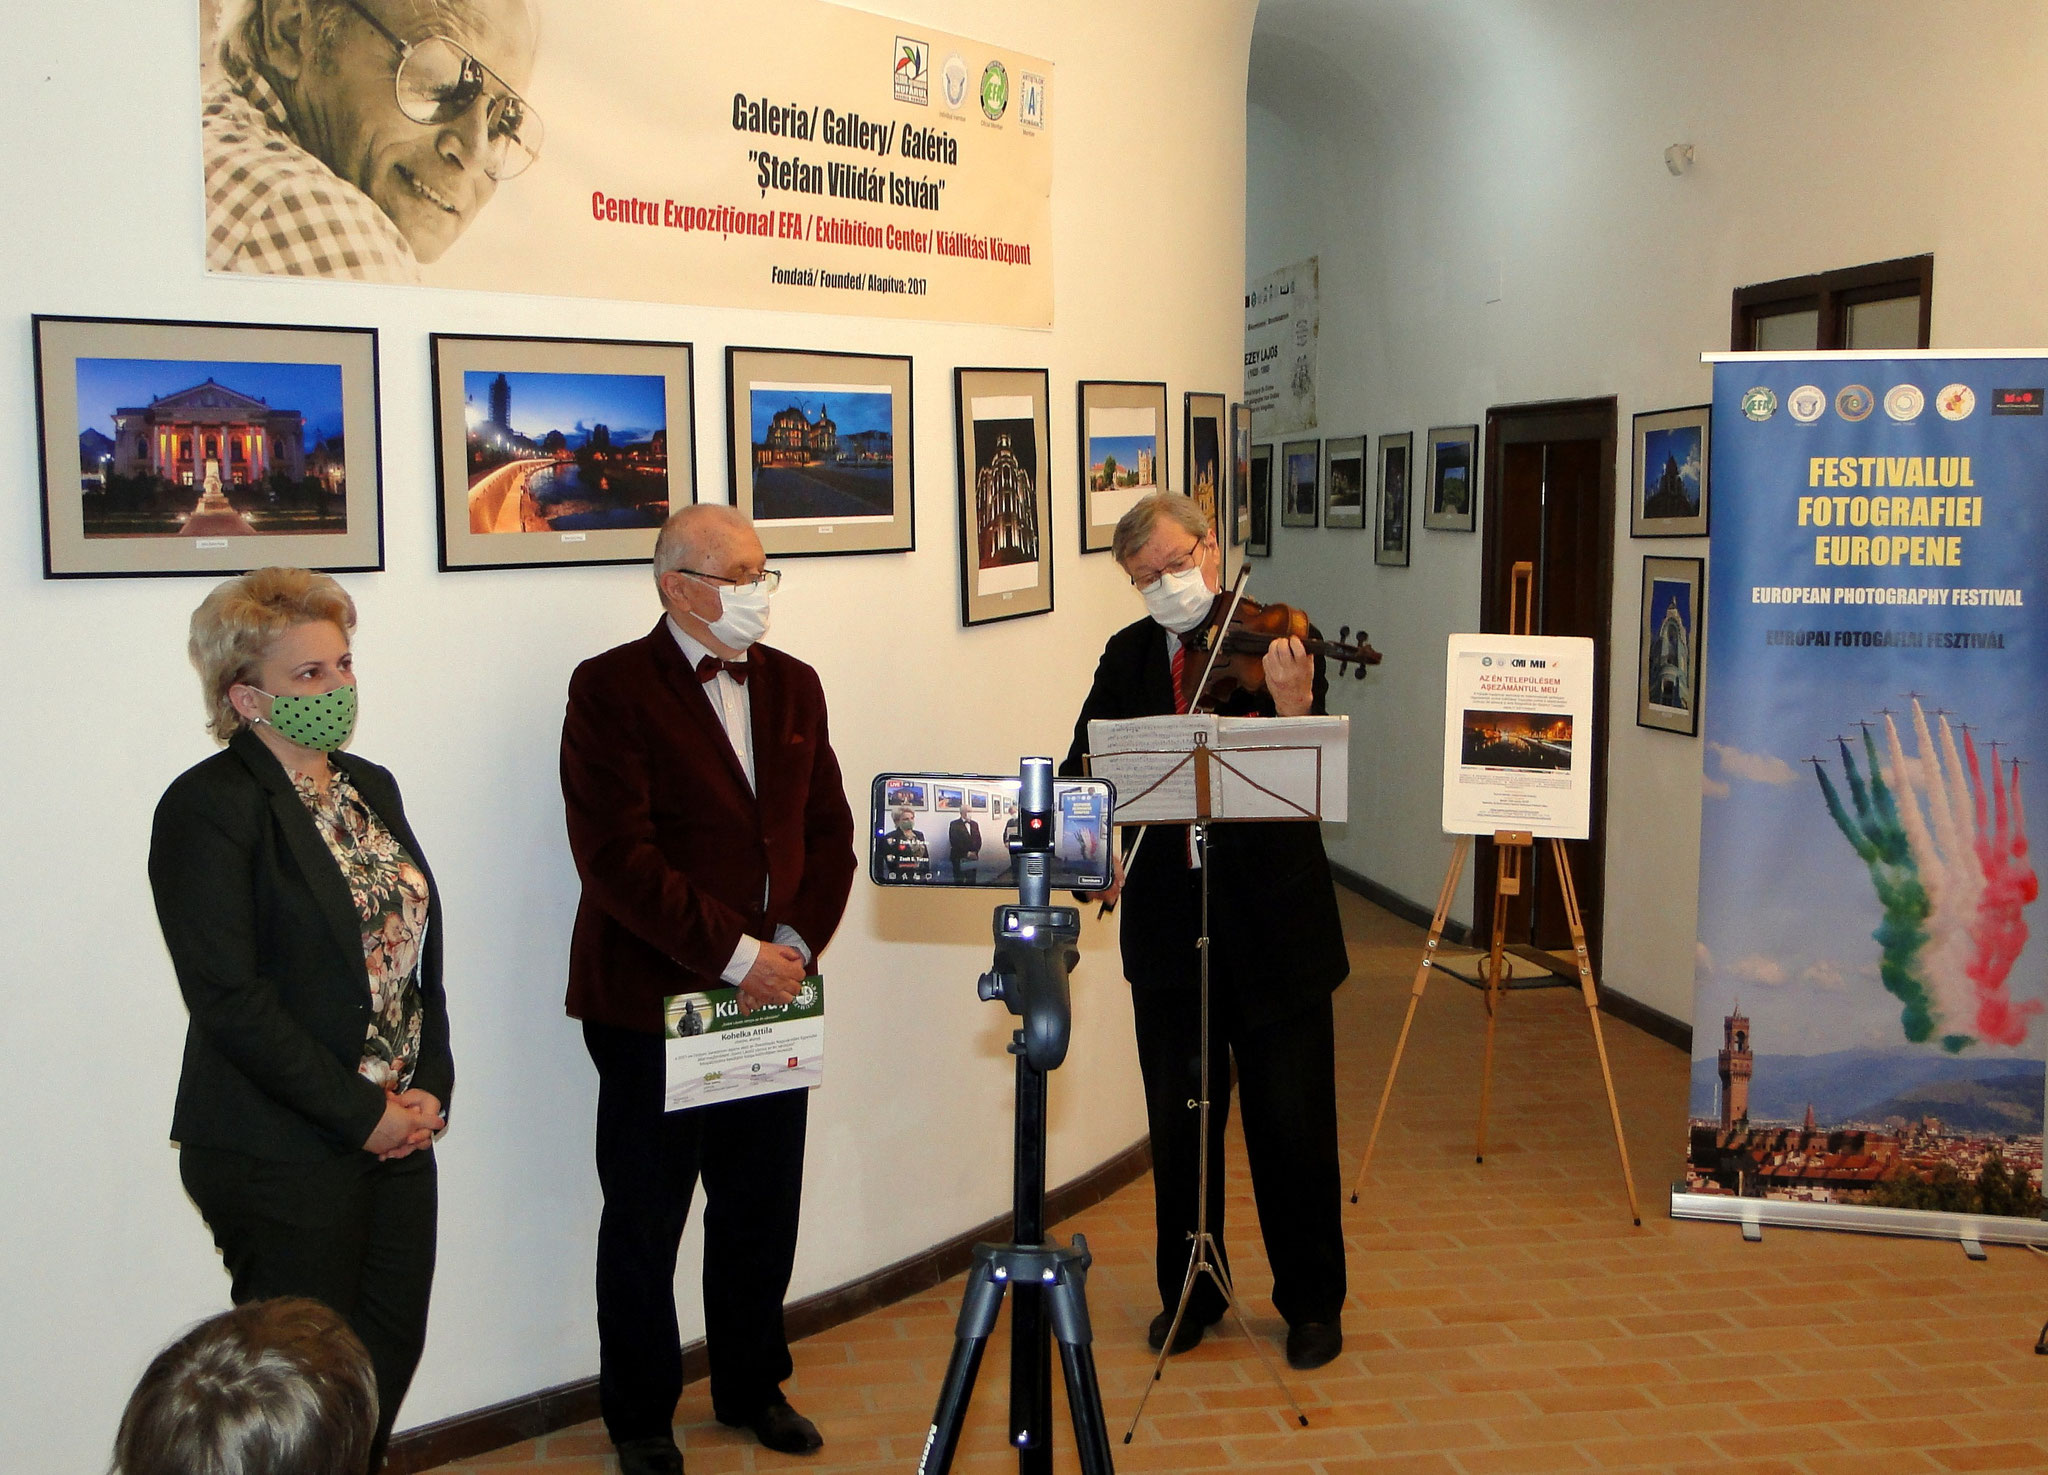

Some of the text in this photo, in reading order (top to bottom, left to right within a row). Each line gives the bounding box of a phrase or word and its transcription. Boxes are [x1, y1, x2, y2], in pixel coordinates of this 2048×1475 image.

[732, 93, 957, 165] Galeria/ Gallery/ Galéria
[828, 161, 885, 203] Vilidár
[592, 191, 659, 226] Centru
[664, 199, 774, 241] Expozițional
[778, 211, 803, 241] EFA
[816, 215, 883, 249] Exhibition
[886, 224, 933, 255] Center/
[936, 229, 988, 261] Kiállítási
[990, 237, 1031, 266] Központ
[907, 277, 927, 296] 2017
[1809, 457, 1974, 487] FESTIVALUL
[1798, 496, 1982, 526] FOTOGRAFIEI
[1815, 536, 1962, 566] EUROPENE
[1752, 587, 2023, 606] EUROPEAN PHOTOGRAPHY FESTIVAL
[1492, 674, 1502, 682] ÉN
[721, 1029, 751, 1041] Kohelka
[752, 1026, 773, 1037] Attila
